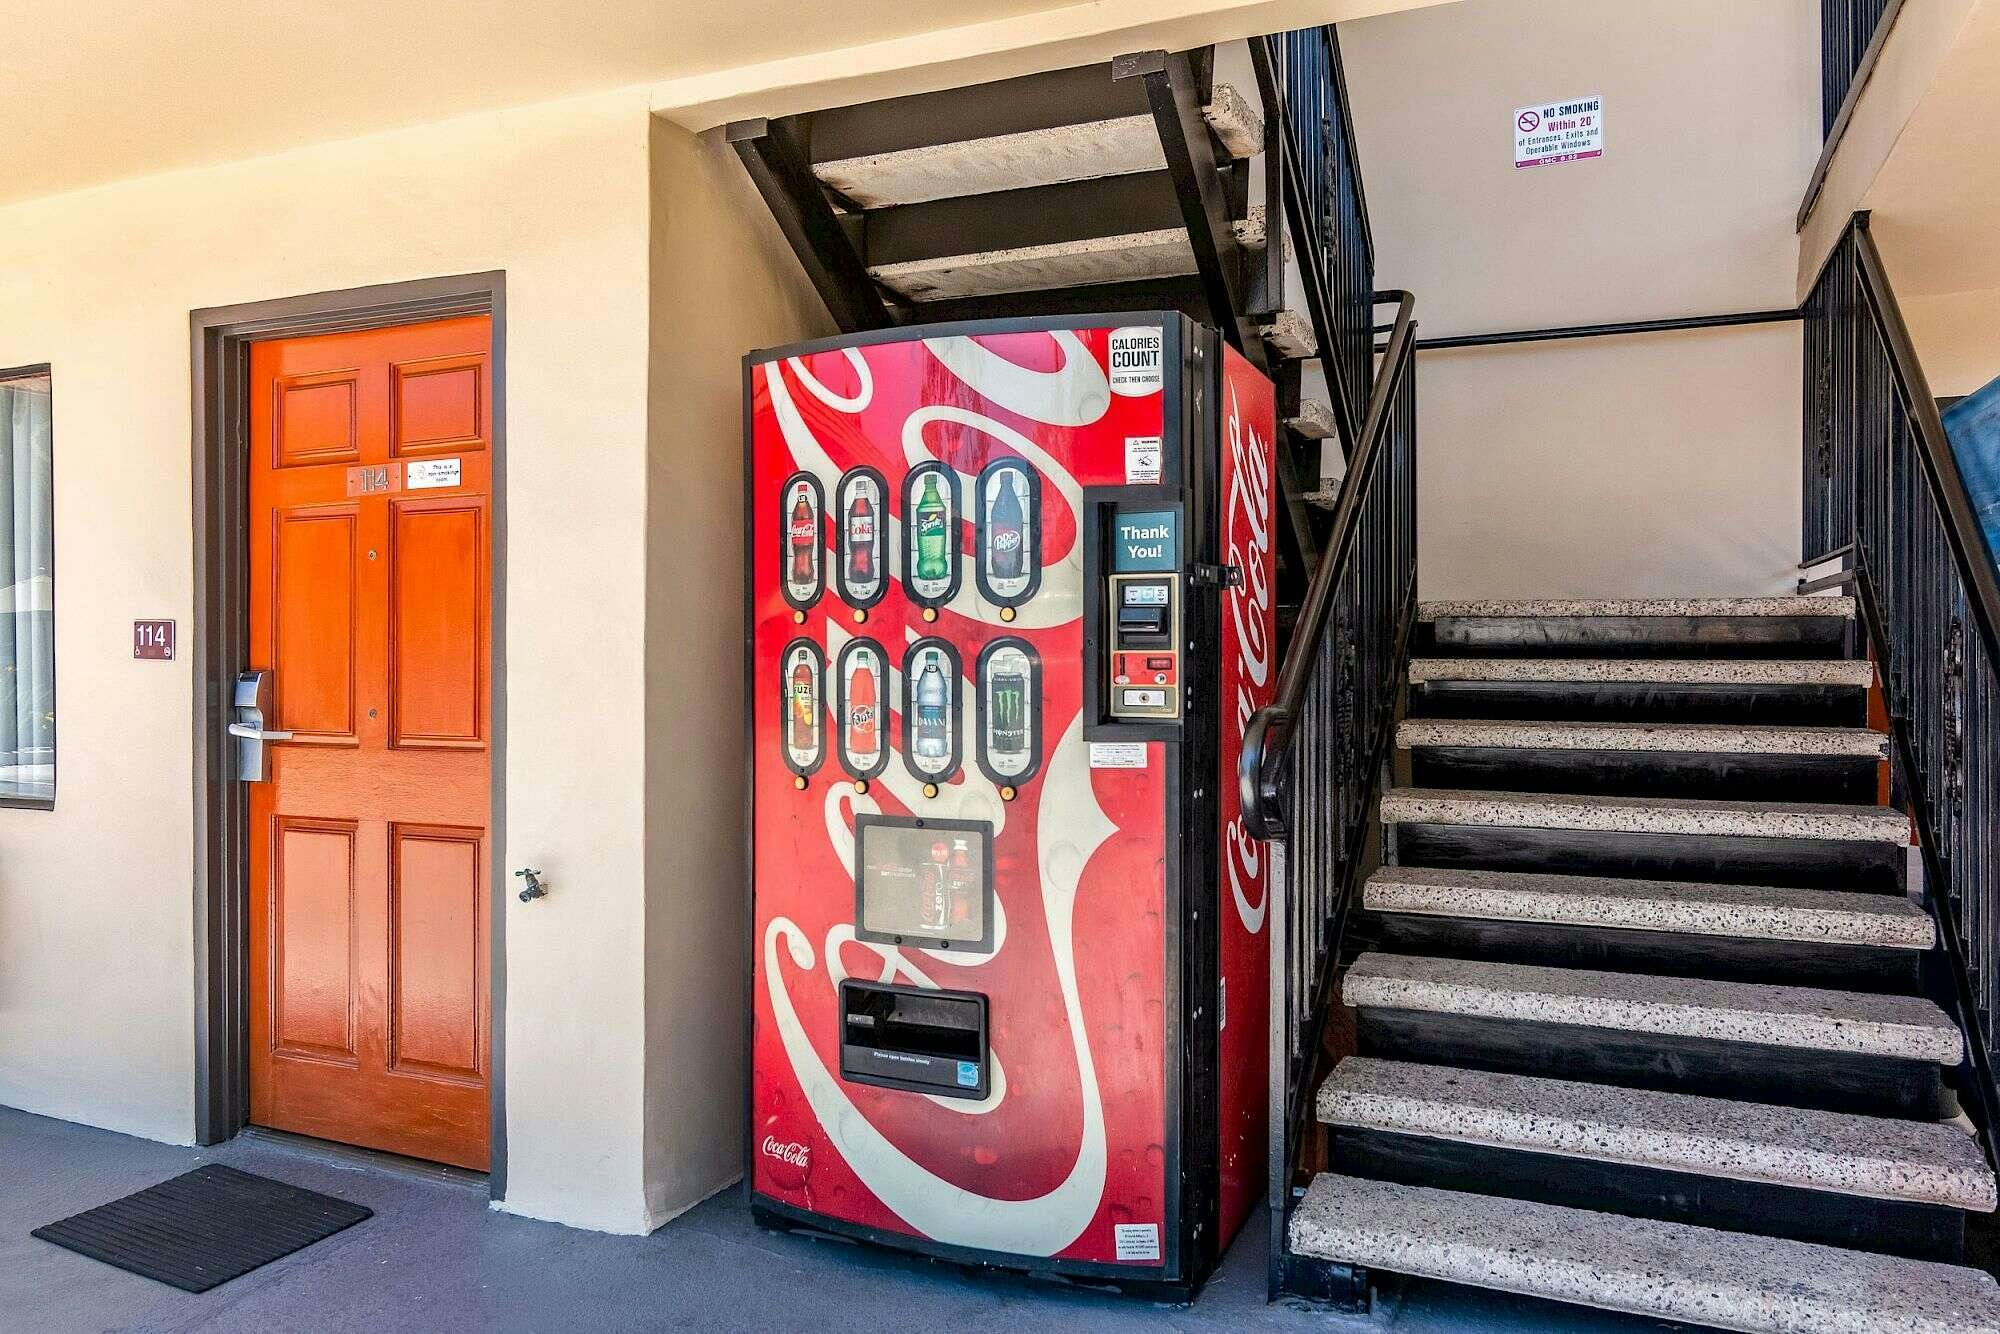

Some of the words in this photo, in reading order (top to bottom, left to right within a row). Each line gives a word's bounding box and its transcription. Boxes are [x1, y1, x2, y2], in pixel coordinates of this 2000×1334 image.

[1543, 107, 1555, 119] NO
[1558, 100, 1599, 117] SMOKING
[1547, 119, 1576, 132] Within
[1518, 138, 1525, 147] of
[1565, 130, 1584, 140] Exits
[1586, 127, 1599, 136] and
[1525, 143, 1558, 155] Operable
[1560, 139, 1591, 150] Windows
[1112, 336, 1160, 351] CALORIES
[1112, 350, 1160, 368] COUNT
[1112, 376, 1128, 384] CHECK
[1129, 375, 1141, 383] THEN
[1141, 375, 1160, 383] CHOOSE
[360, 468, 389, 491] 114
[851, 523, 873, 536] Coke
[1120, 524, 1169, 540] Thank
[1127, 544, 1163, 559] You!
[136, 624, 166, 647] 114
[794, 686, 812, 694] FUZE
[935, 882, 944, 912] zero
[762, 1135, 811, 1167] Coca-Cola
